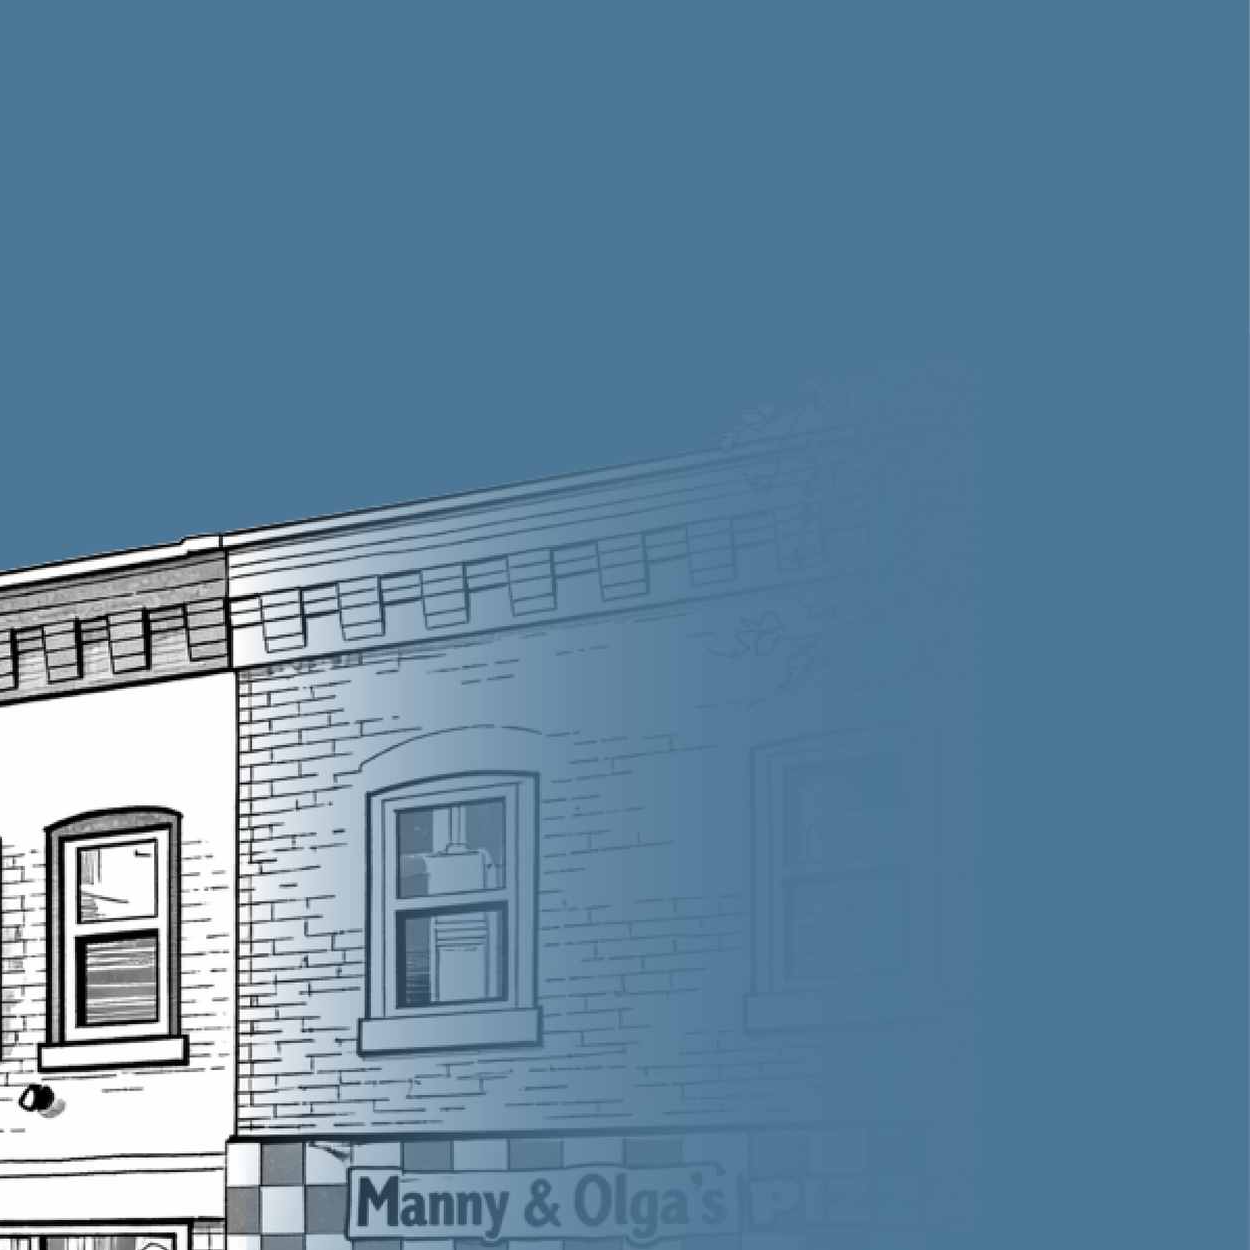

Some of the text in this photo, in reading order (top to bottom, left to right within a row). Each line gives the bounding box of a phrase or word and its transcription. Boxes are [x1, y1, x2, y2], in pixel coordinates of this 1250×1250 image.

[356, 1174, 509, 1239] Manny
[524, 1177, 562, 1228] &
[574, 1172, 728, 1239] Olga's
